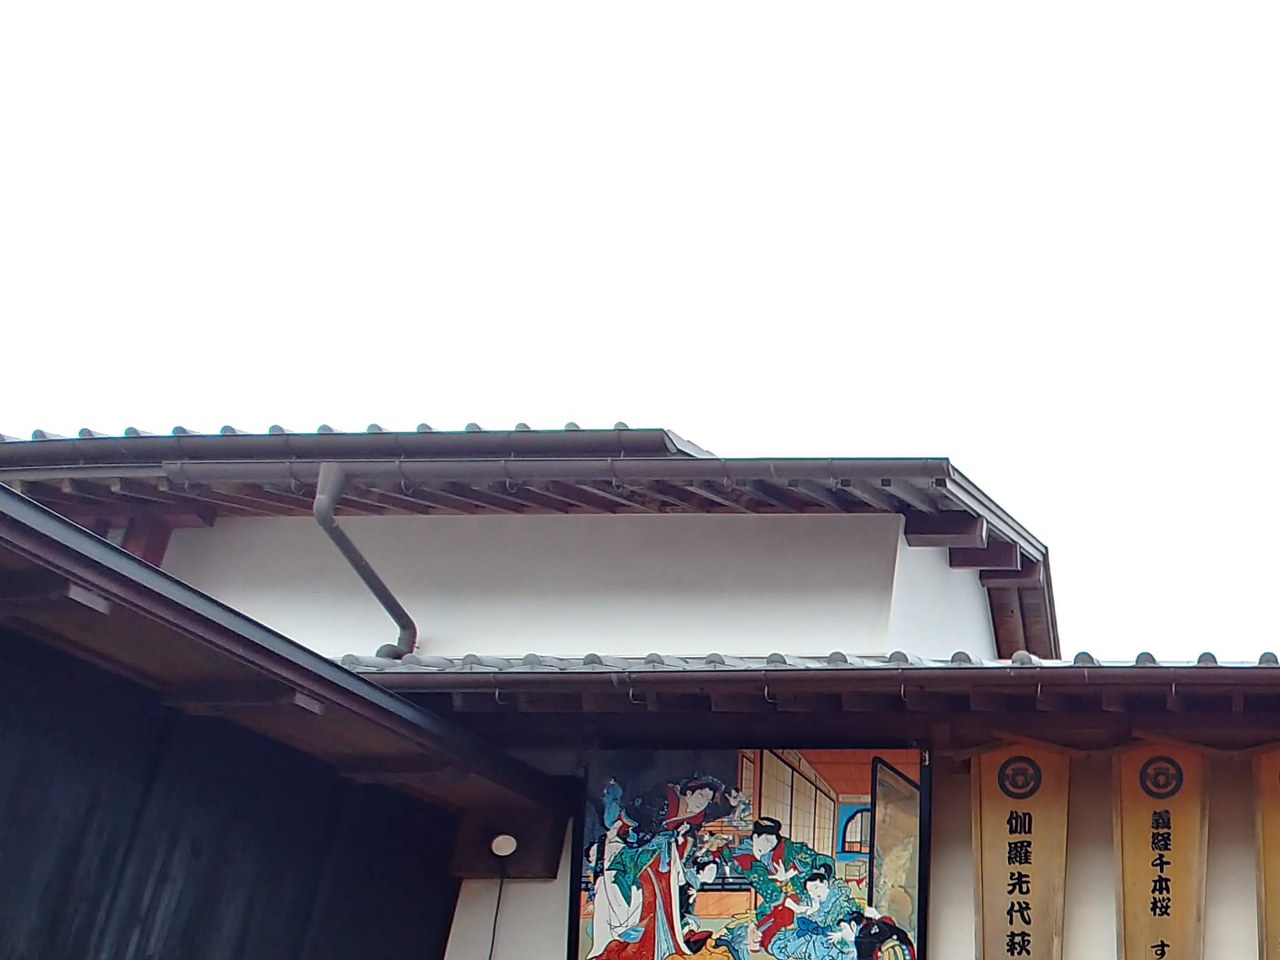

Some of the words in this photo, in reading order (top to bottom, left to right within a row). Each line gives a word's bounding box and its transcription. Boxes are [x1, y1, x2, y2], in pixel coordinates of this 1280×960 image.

[1006, 810, 1033, 957] 伽羅先代萩
[1149, 809, 1172, 918] 義経千本桜
